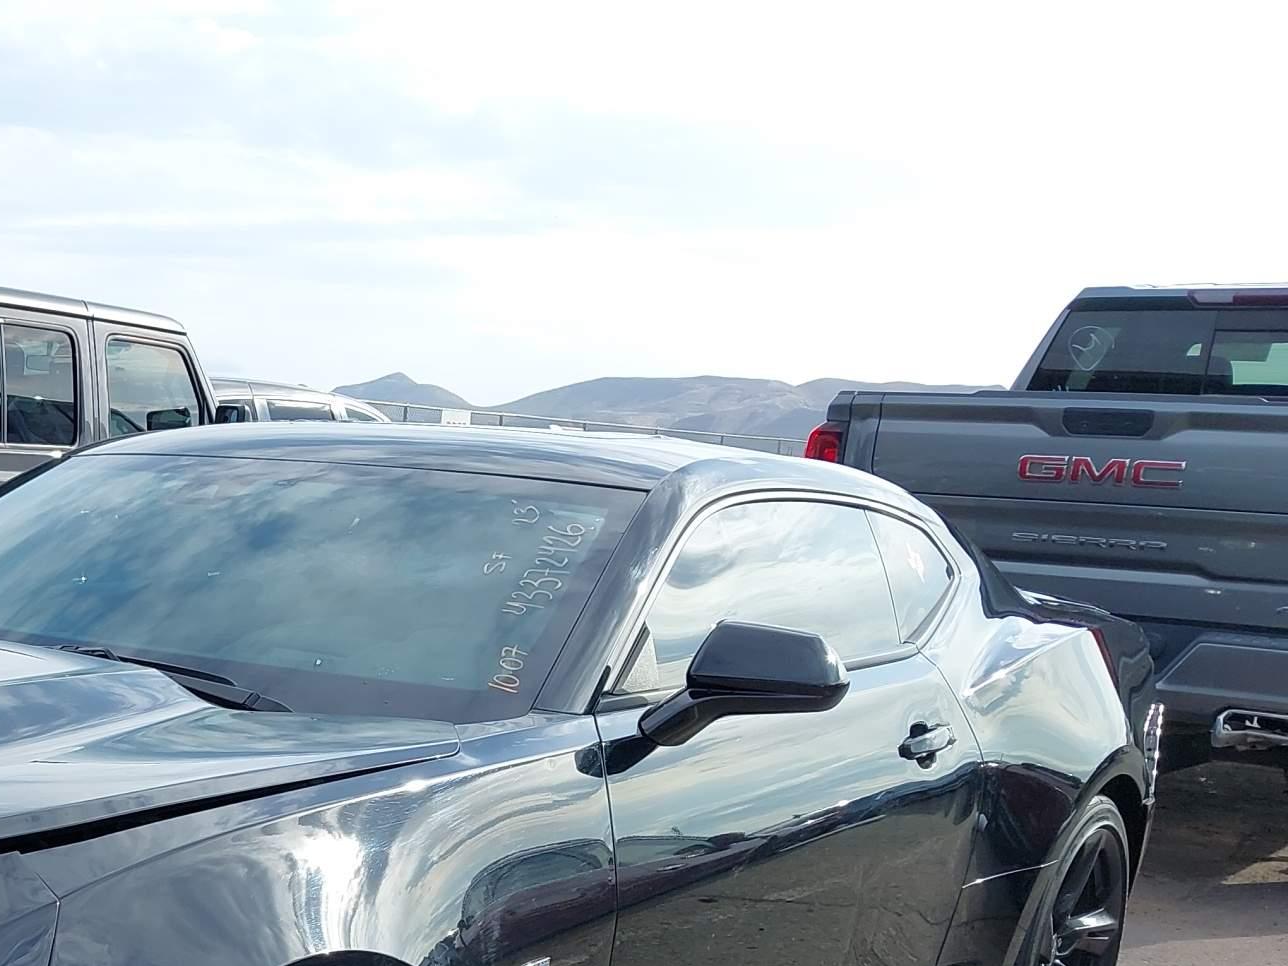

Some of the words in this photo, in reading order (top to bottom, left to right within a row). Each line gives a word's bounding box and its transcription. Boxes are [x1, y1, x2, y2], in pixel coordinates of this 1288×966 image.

[1018, 454, 1187, 488] GMC
[1012, 531, 1168, 550] SIERRA
[501, 523, 587, 615] 43372426
